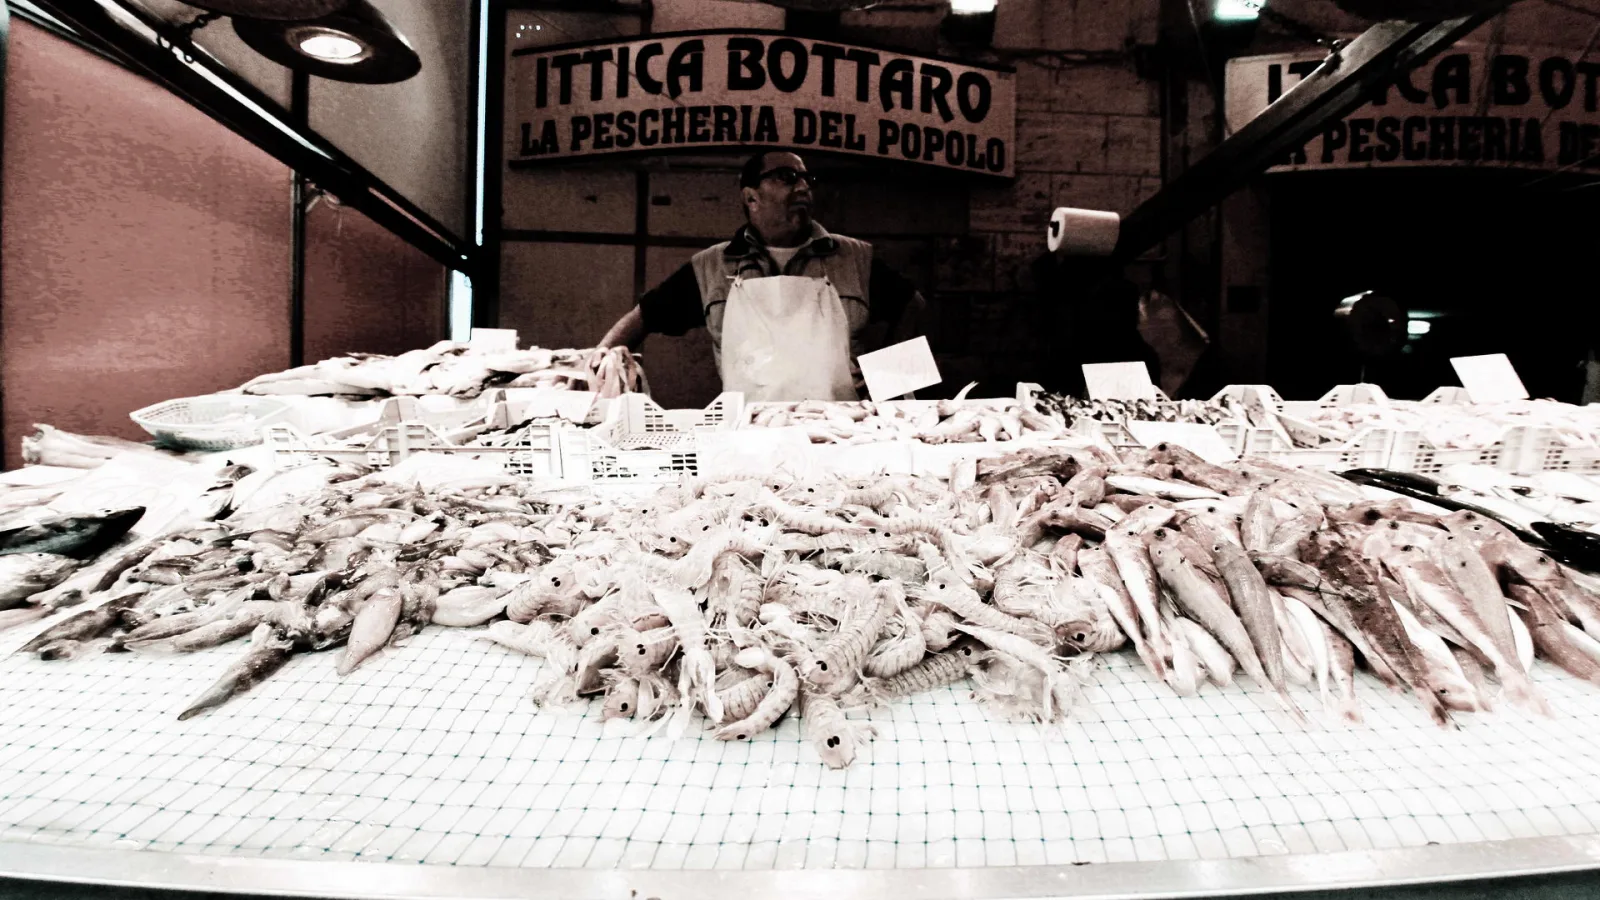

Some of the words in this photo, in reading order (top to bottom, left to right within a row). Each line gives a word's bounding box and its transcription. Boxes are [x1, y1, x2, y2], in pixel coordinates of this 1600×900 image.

[535, 38, 704, 108] ITTICA
[727, 37, 992, 124] BOTTARO
[1268, 54, 1471, 109] ICA
[1492, 55, 1600, 112] BOT
[520, 119, 559, 157] LA
[571, 105, 779, 150] PESCHERIA
[792, 107, 865, 151] DEL
[877, 118, 1006, 172] POPOLO
[1321, 115, 1544, 163] PESCHERIA
